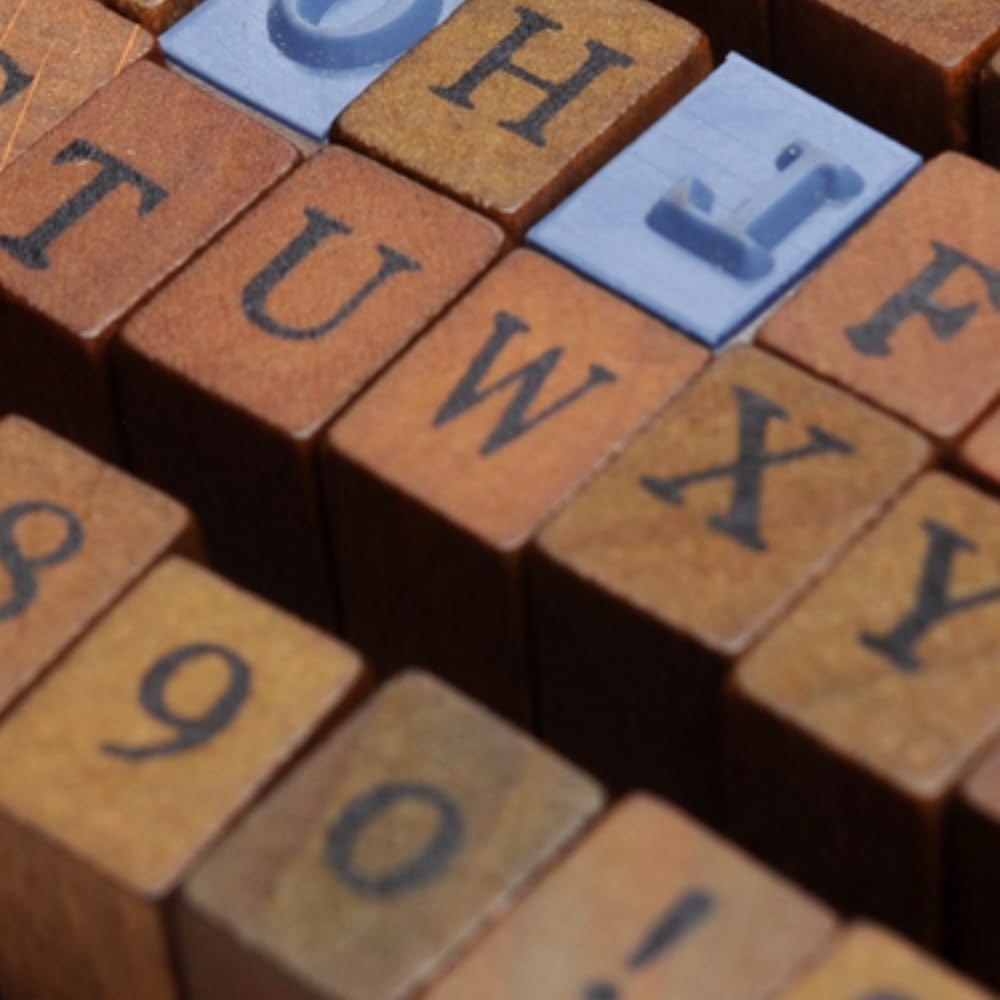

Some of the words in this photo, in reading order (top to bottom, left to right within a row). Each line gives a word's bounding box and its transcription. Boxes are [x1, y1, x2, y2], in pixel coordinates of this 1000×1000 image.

[428, 5, 635, 147] H
[242, 207, 422, 340] U
[846, 243, 1000, 356] F
[434, 312, 617, 455] W
[641, 386, 855, 551] X
[860, 520, 1000, 674] Y
[105, 643, 252, 760] 9
